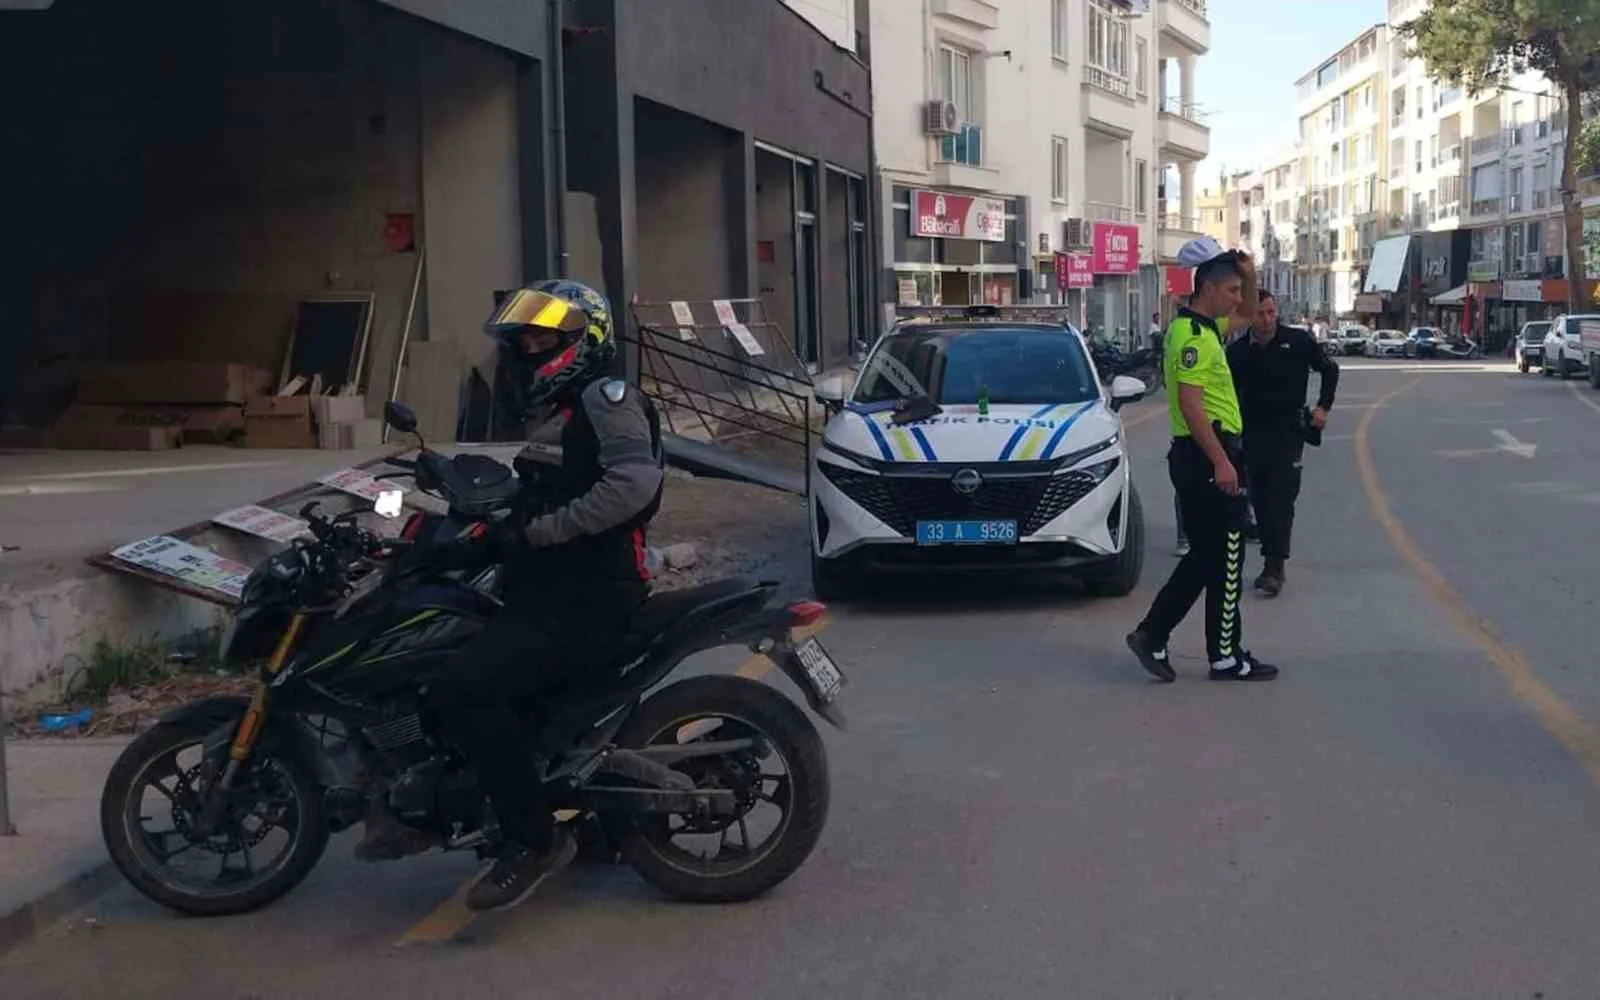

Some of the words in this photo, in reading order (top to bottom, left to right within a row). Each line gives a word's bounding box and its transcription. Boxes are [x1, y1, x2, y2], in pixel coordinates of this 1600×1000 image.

[927, 523, 944, 539] 33
[955, 523, 963, 538] A
[980, 523, 1014, 538] 9526
